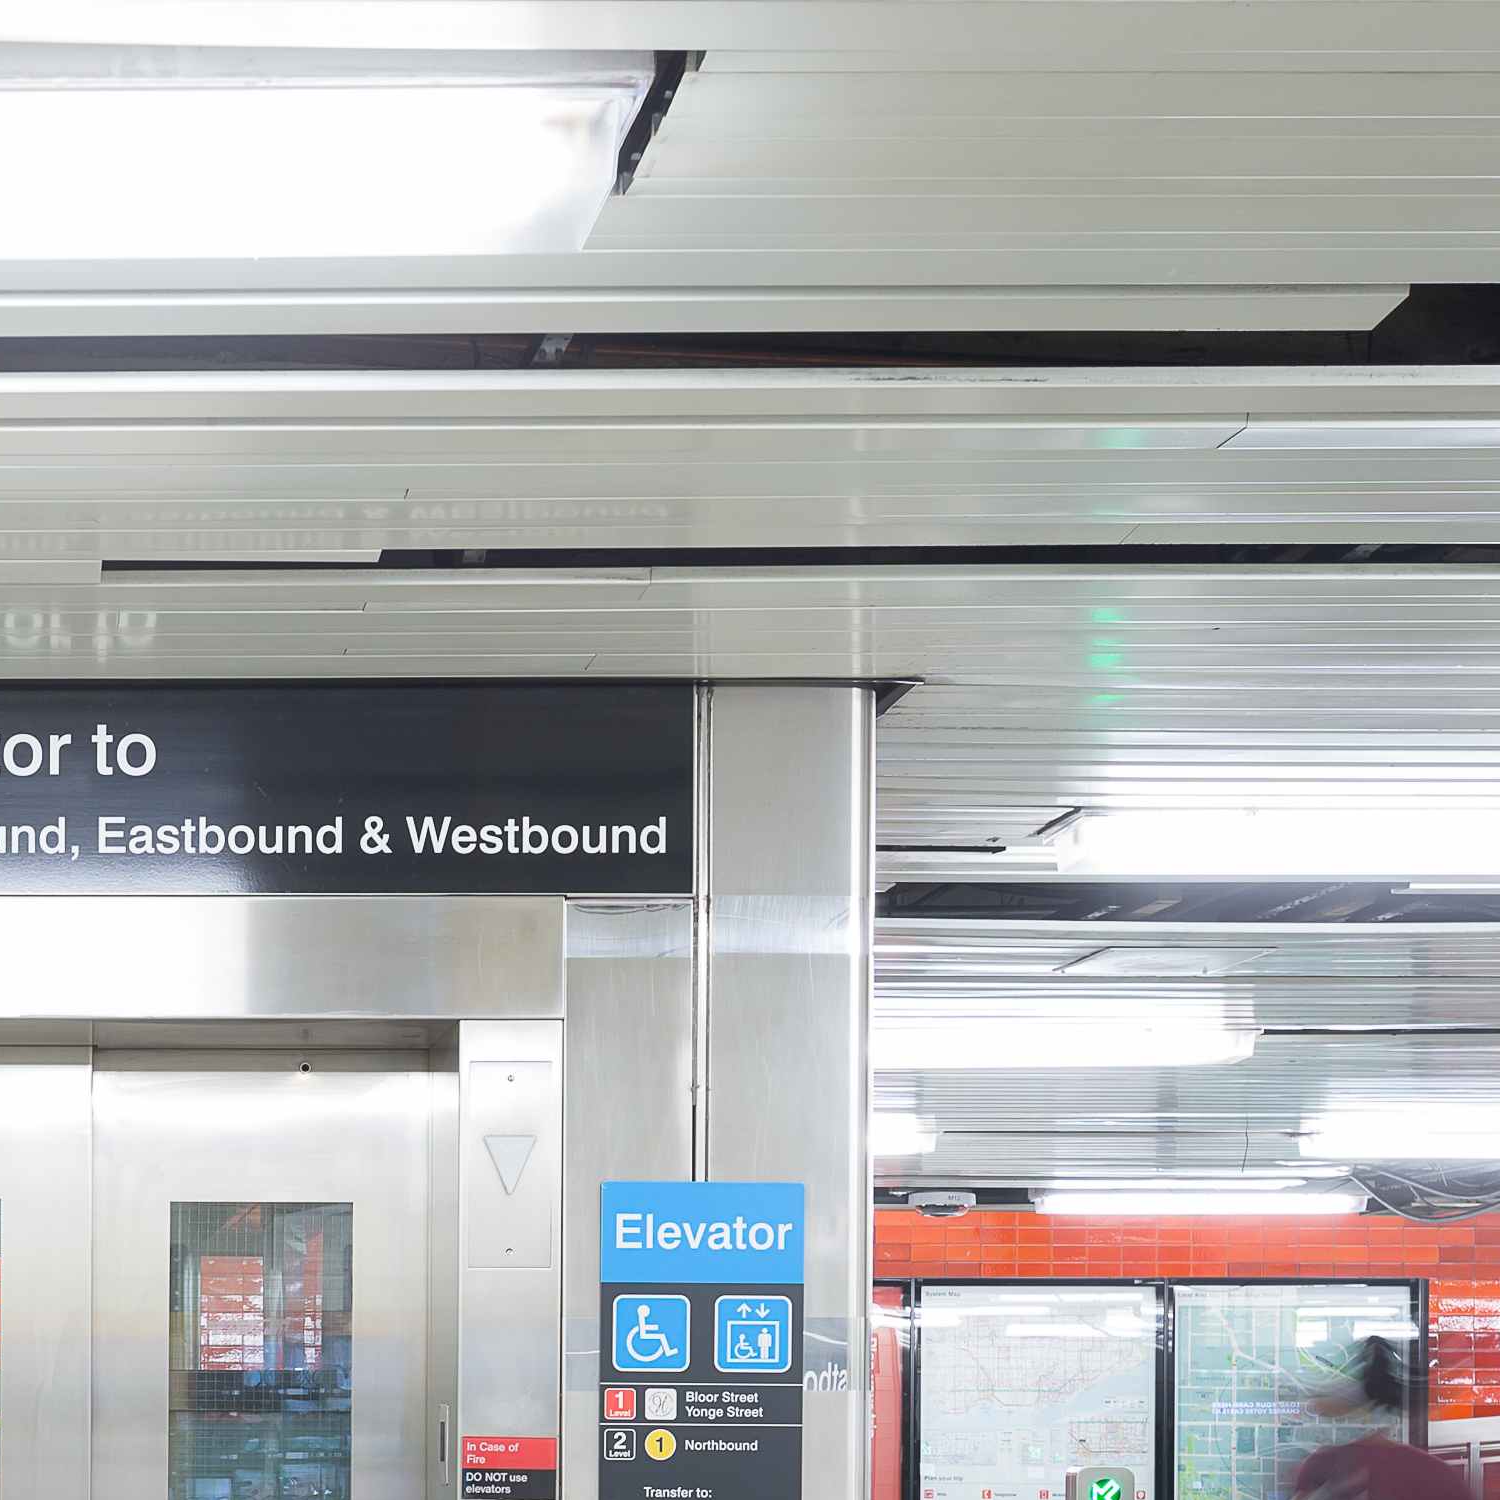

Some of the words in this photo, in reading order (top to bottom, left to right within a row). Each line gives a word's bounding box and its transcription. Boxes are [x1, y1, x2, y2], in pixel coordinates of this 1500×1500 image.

[91, 723, 157, 777] to
[96, 814, 345, 857] Eastbound
[359, 815, 393, 855] &
[404, 814, 669, 857] Westbound
[615, 1213, 793, 1251] Elevator
[614, 1391, 625, 1408] 1
[685, 1390, 720, 1403] Bloor
[721, 1391, 759, 1403] Street
[609, 1409, 631, 1417] Level
[685, 1405, 724, 1420] Yonge
[726, 1405, 764, 1418] Street
[466, 1441, 477, 1452] In
[479, 1441, 506, 1452] Case
[508, 1442, 520, 1452] of
[614, 1432, 626, 1449] 2
[656, 1437, 664, 1453] 1
[684, 1439, 759, 1452] Northbound
[466, 1453, 486, 1464] Fire
[608, 1449, 631, 1458] Level
[465, 1471, 483, 1482] DO
[484, 1472, 508, 1483] NOT
[509, 1474, 528, 1483] use
[465, 1483, 512, 1494] elevators
[643, 1486, 694, 1499] Transfer
[695, 1487, 713, 1499] to:
